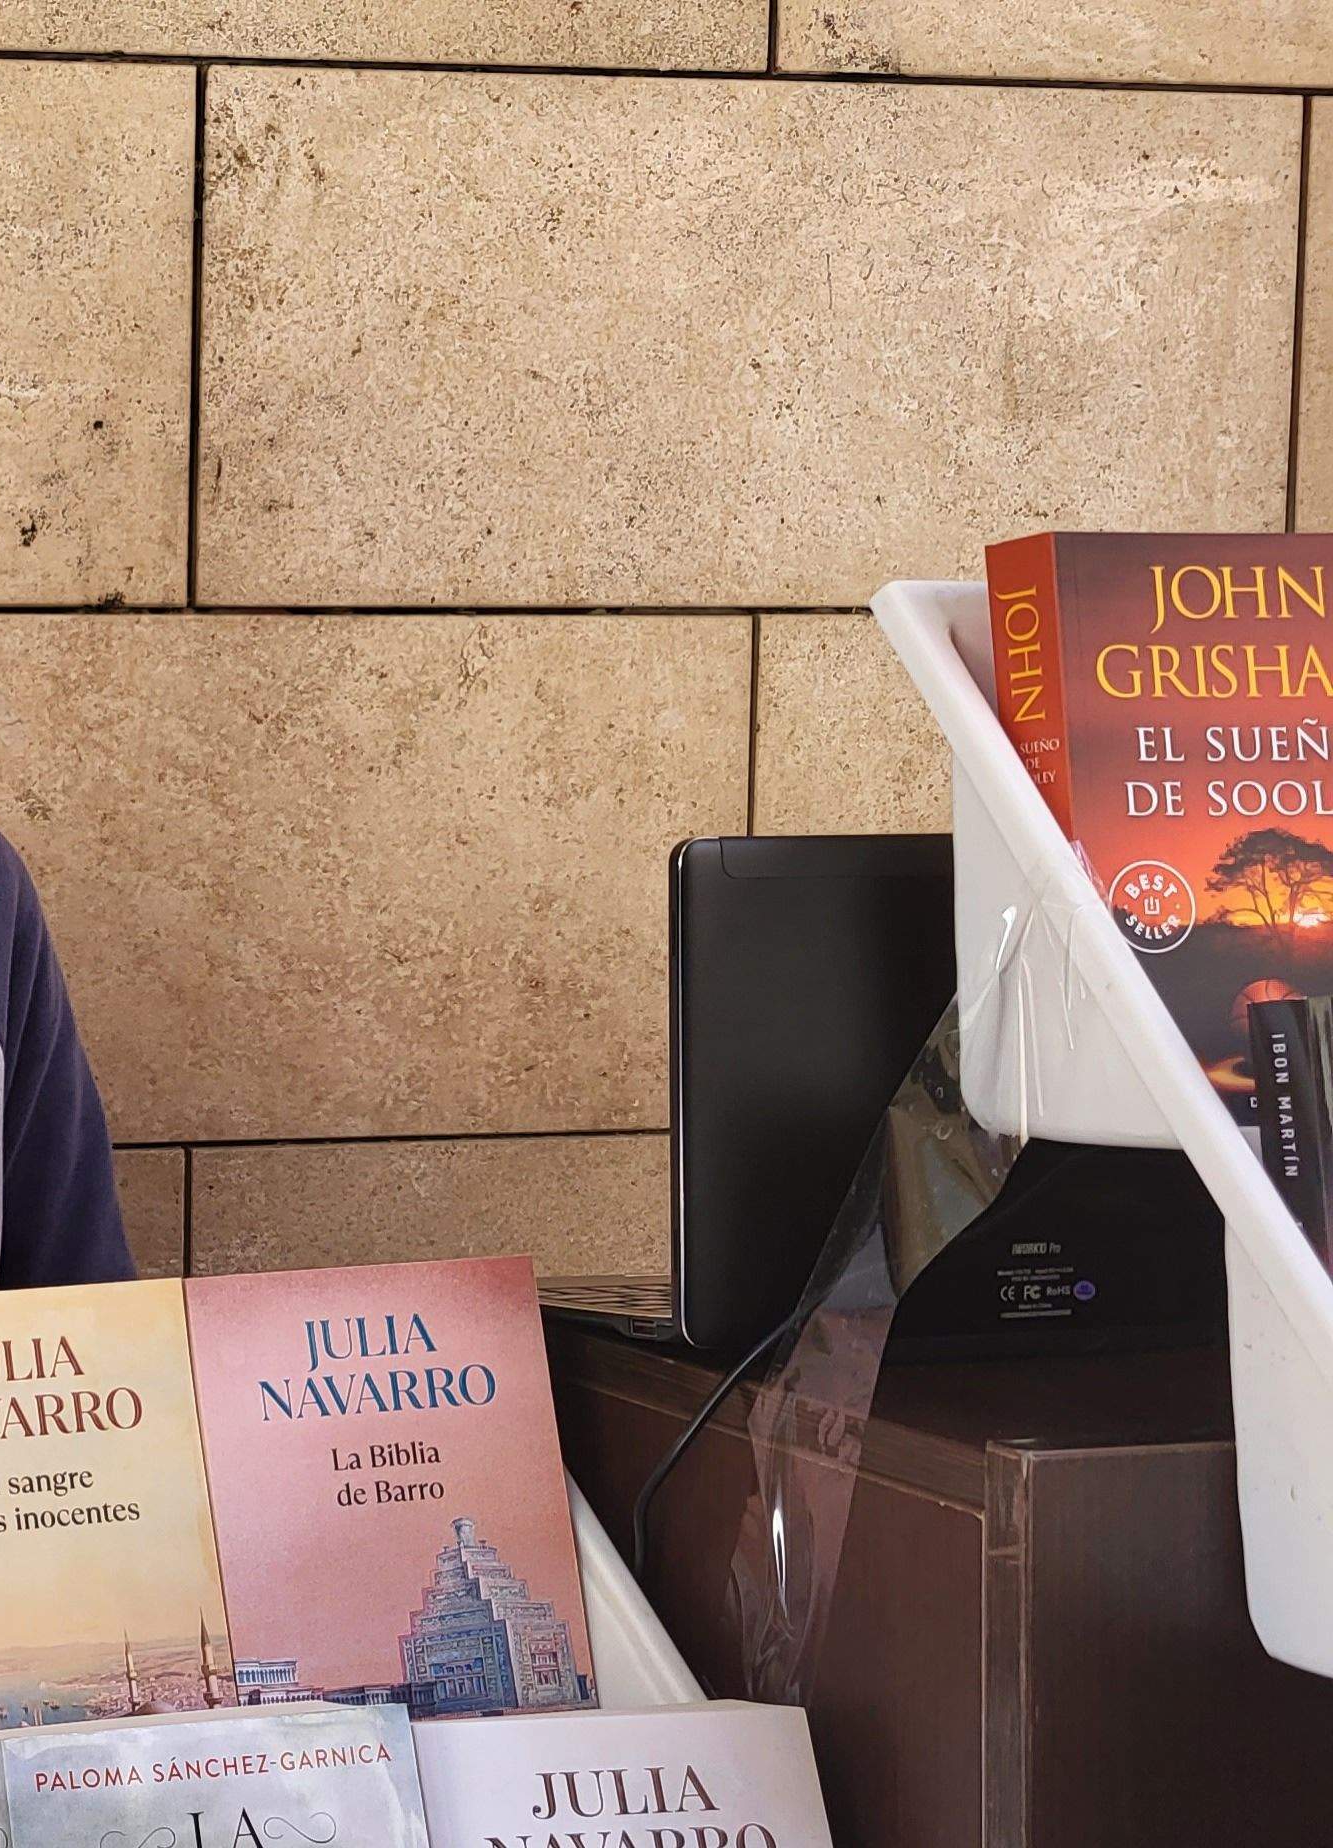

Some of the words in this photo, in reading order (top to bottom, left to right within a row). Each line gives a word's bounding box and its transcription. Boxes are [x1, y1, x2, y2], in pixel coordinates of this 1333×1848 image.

[1149, 565, 1326, 634] JOHN
[995, 585, 1046, 722] JOHN
[1136, 726, 1185, 762] EL
[1205, 717, 1330, 763] SUEÑ
[1124, 780, 1186, 817] DE
[1207, 780, 1333, 817] SOOL
[1124, 873, 1179, 899] BEST
[1125, 910, 1182, 941] SELLER
[1271, 1033, 1289, 1084] IBON
[1277, 1096, 1299, 1178] MARTÍN
[305, 1313, 437, 1372] JULIA
[258, 1363, 496, 1422] NAVARRO
[331, 1447, 362, 1472] La
[370, 1440, 441, 1469] Biblia
[7, 1470, 94, 1497] sangre
[336, 1481, 368, 1507] de
[374, 1477, 445, 1503] Barro
[14, 1500, 141, 1532] inocentes
[35, 1765, 143, 1793] PALOMA
[154, 1742, 392, 1785] SÁNCHEZ-GARNICA
[532, 1765, 721, 1820] JULIA
